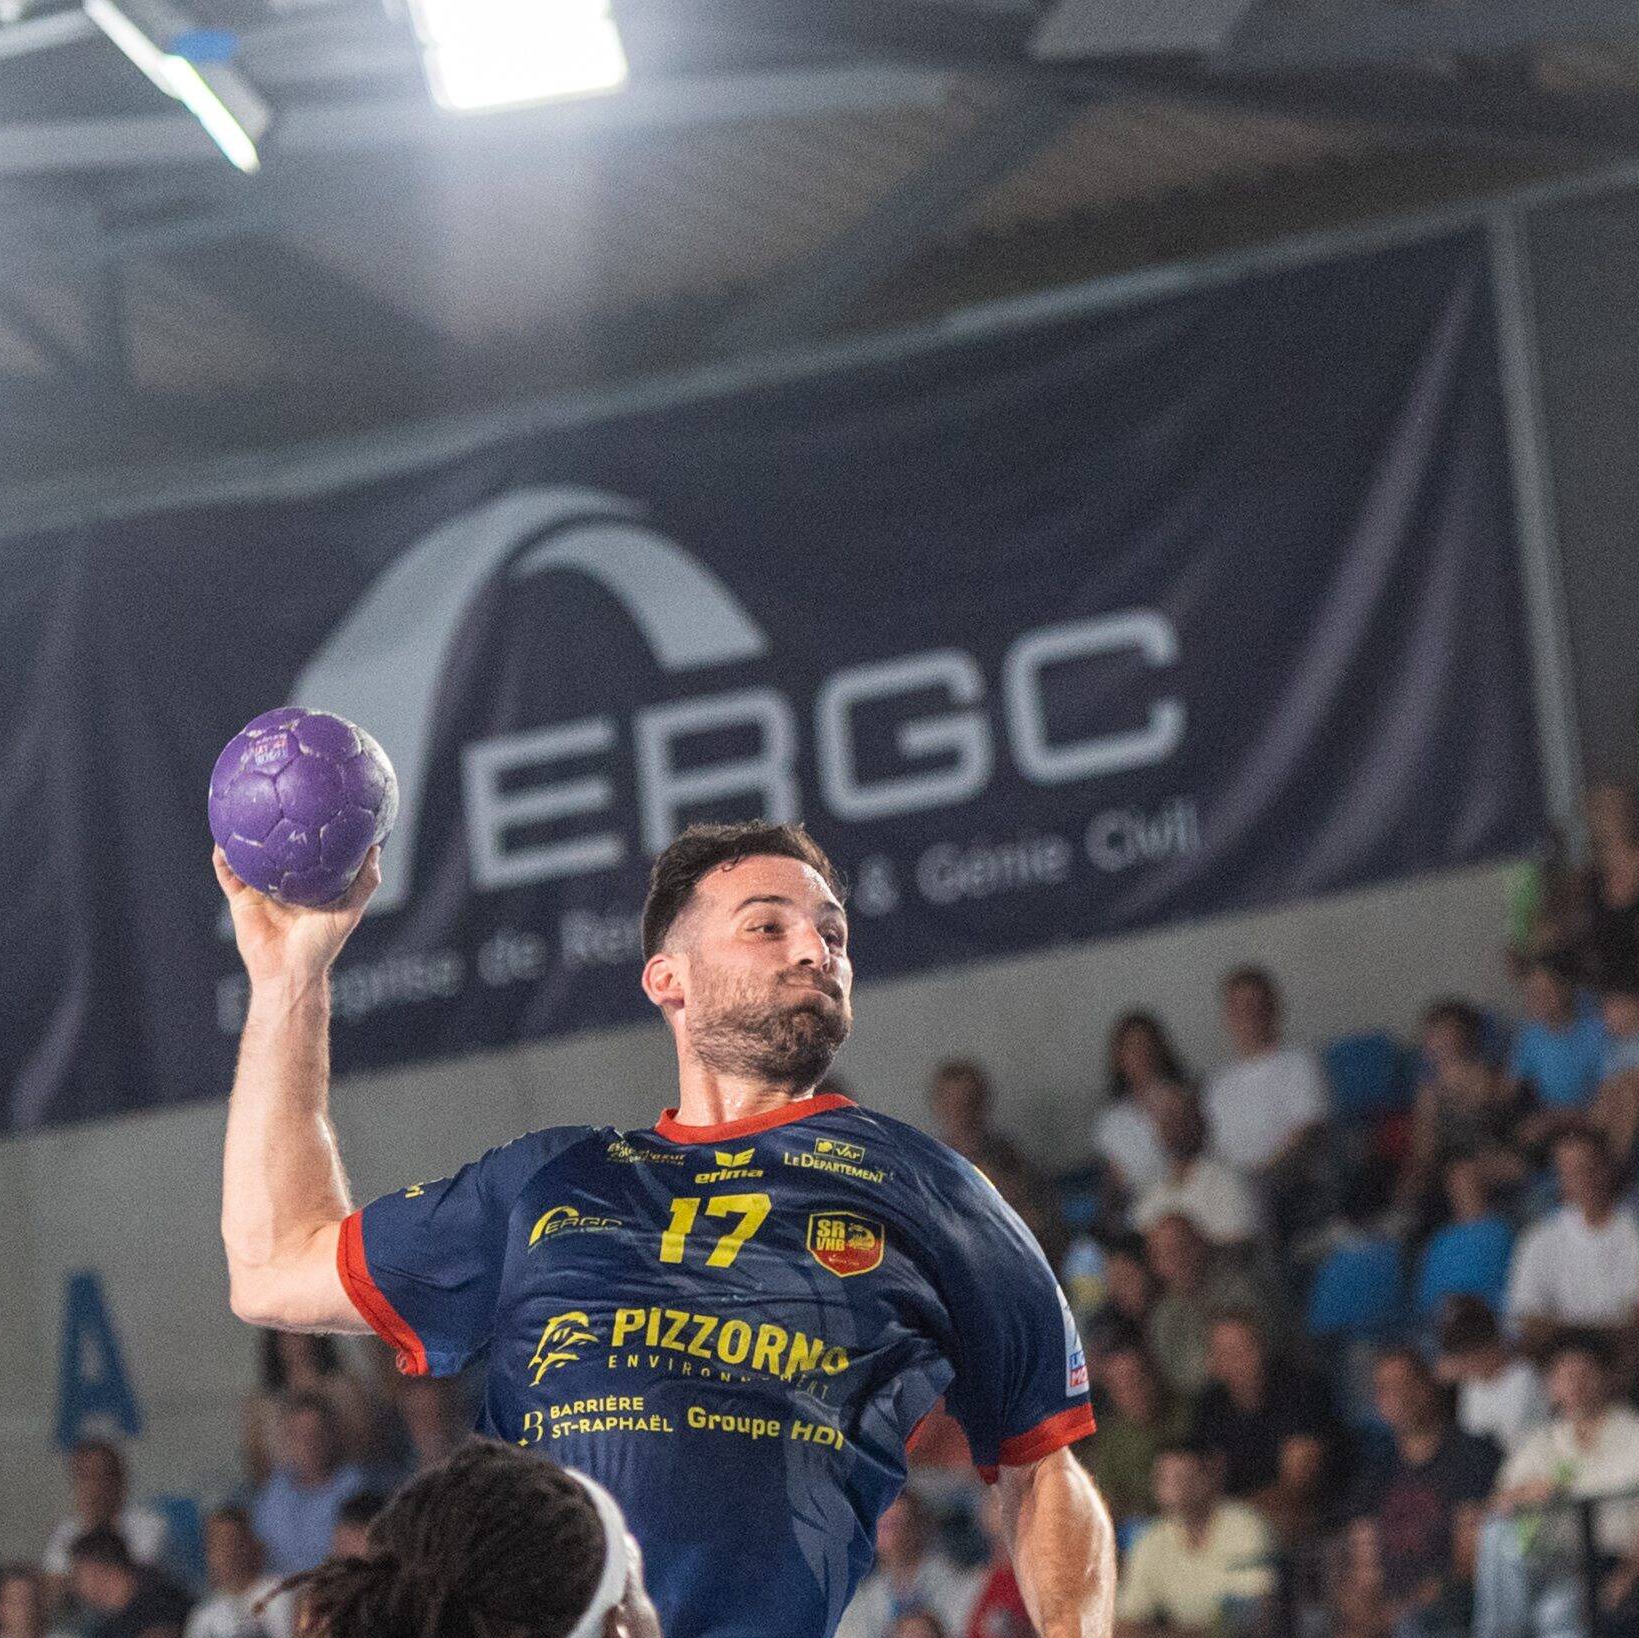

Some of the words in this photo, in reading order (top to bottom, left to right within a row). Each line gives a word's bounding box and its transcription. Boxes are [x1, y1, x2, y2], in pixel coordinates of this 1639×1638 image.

[461, 609, 1187, 890] ERGC
[695, 1168, 764, 1184] erima
[659, 1193, 772, 1268] 17
[817, 1219, 845, 1239] SR
[817, 1238, 845, 1251] VHB
[612, 1307, 850, 1378] PIZZORNO
[550, 1395, 644, 1419] BARRIÈRE
[551, 1415, 674, 1439] ST-RAPHAËL
[687, 1406, 780, 1439] Groupe
